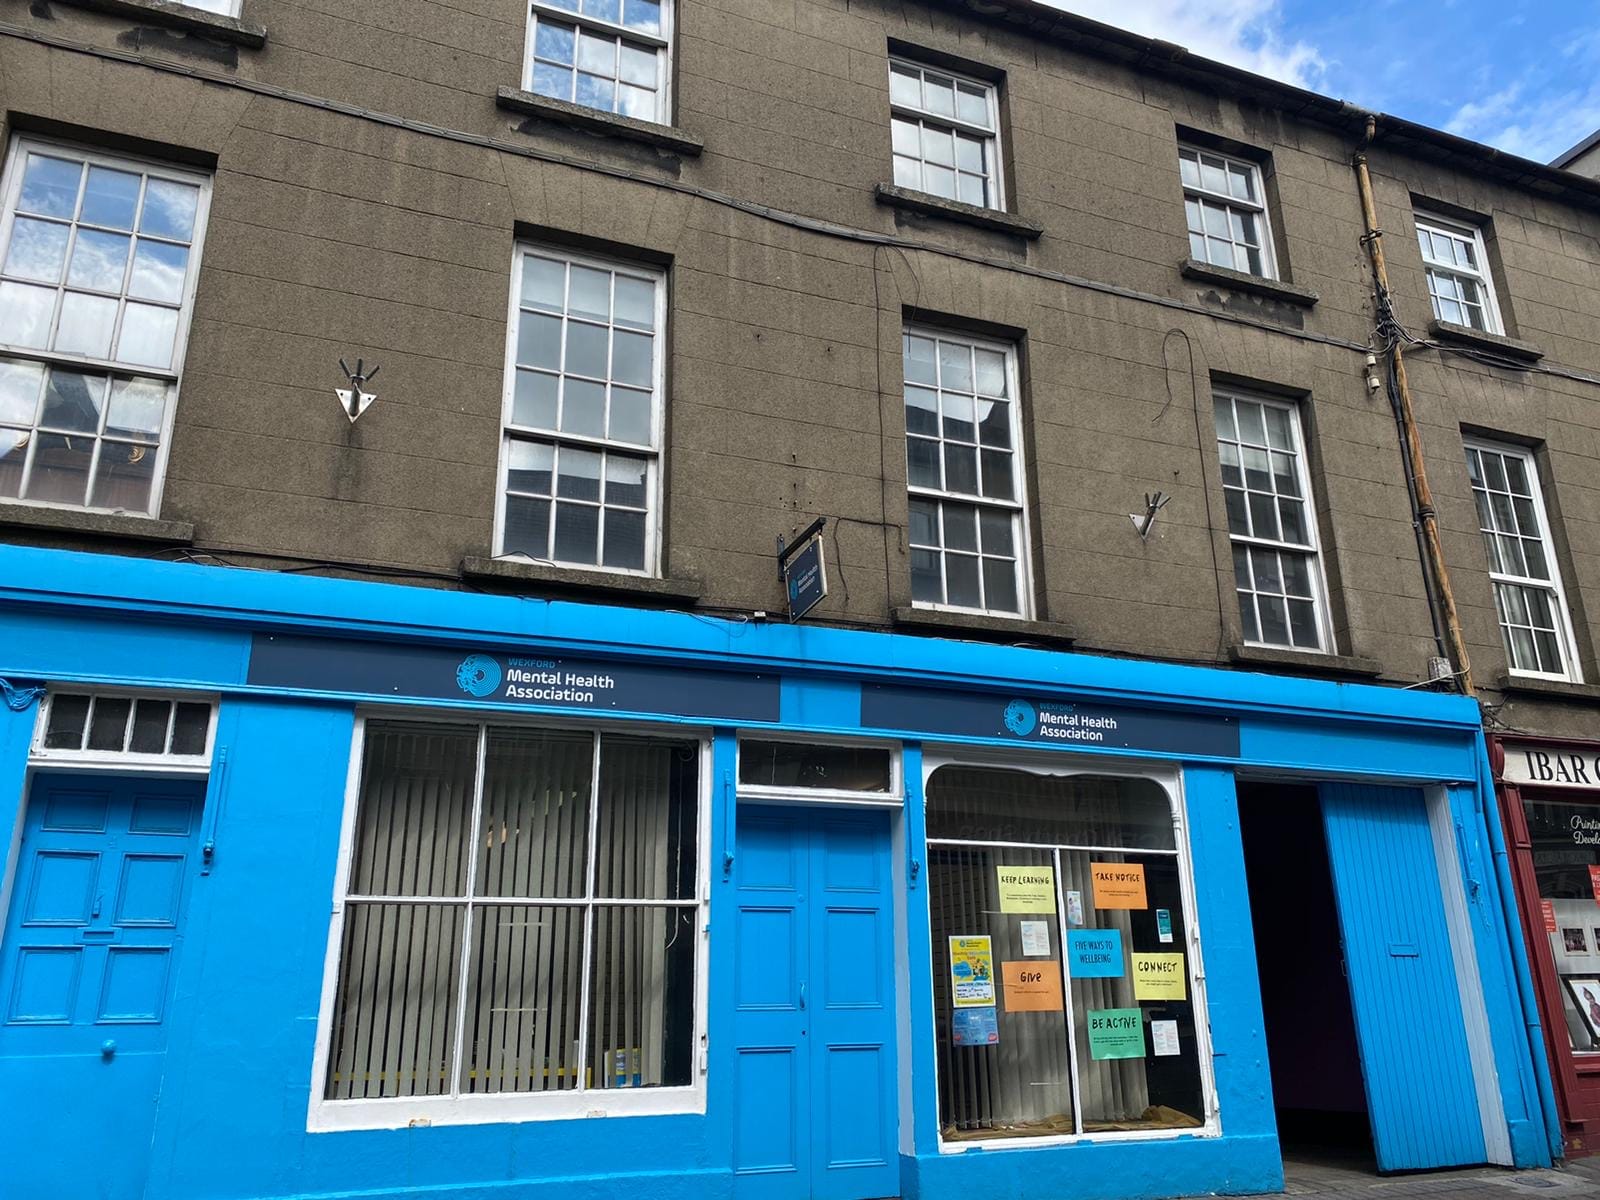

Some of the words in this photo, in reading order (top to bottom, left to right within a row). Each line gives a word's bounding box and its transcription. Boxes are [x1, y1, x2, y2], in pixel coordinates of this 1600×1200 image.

[508, 658, 556, 669] WEXFORD
[507, 669, 562, 685] Mental
[565, 673, 614, 689] Health
[505, 684, 594, 703] Association
[1040, 711, 1079, 726] Mental
[1081, 716, 1117, 730] Health
[1040, 725, 1103, 741] Association
[1523, 751, 1592, 784] IBAR
[1001, 876, 1017, 884] KEEP
[1018, 875, 1050, 885] LEARNING
[1095, 872, 1113, 881] TAKE
[1115, 873, 1140, 882] NOTICE
[1075, 941, 1087, 950] FIVE
[1089, 941, 1105, 950] WAYS
[1105, 940, 1113, 950] TO
[1080, 954, 1112, 964] WELLBEING
[1138, 961, 1178, 973] CONNECT
[1092, 1018, 1104, 1029] BE
[1106, 1017, 1137, 1029] ACTIVE
